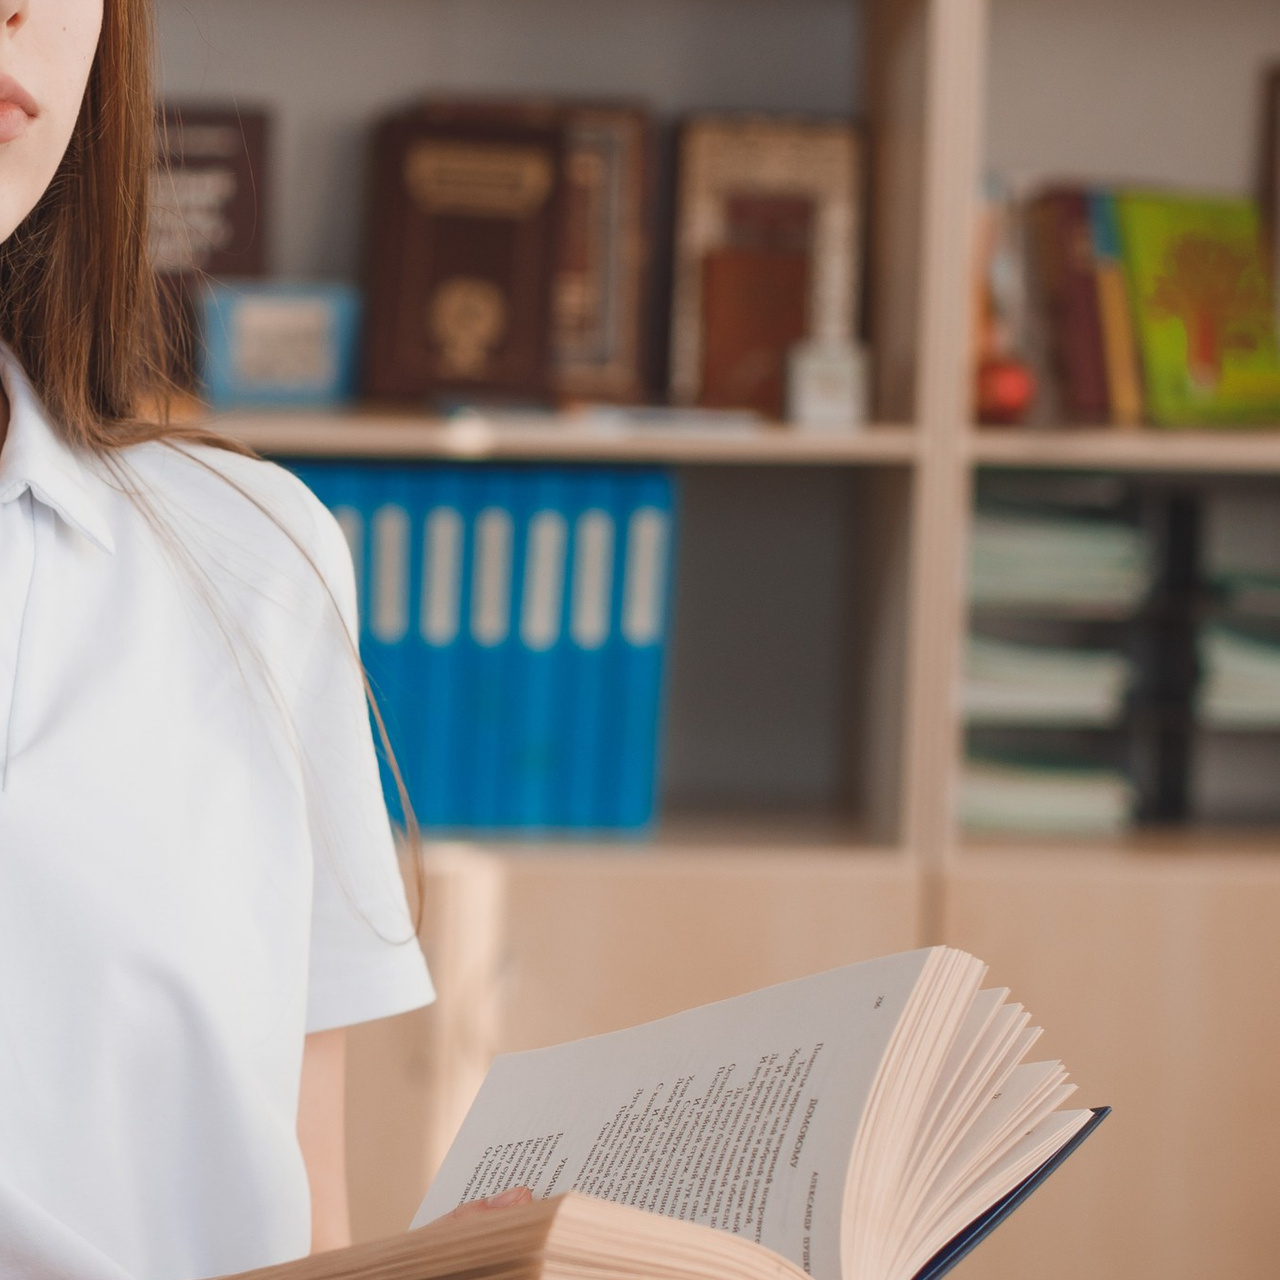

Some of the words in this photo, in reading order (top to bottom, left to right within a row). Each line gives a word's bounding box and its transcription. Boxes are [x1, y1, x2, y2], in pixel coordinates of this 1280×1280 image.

[763, 1067, 772, 1078] не
[768, 1053, 779, 1065] Да
[782, 1048, 801, 1077] Храни
[790, 1061, 806, 1083] Тебя
[667, 1078, 685, 1103] Люби
[679, 1075, 695, 1098] Ходи
[700, 1066, 726, 1109] Постигни
[709, 1063, 736, 1108] Останься,
[743, 1066, 762, 1091] ветра
[623, 1088, 644, 1112] Луга,
[733, 1087, 744, 1100] Да
[749, 1080, 766, 1110] вредят
[754, 1076, 777, 1123] скромную
[777, 1084, 794, 1115] молю,
[634, 1092, 658, 1133] калиткой
[657, 1105, 670, 1122] мой
[664, 1099, 682, 1129] вокруг
[687, 1108, 695, 1118] от
[709, 1090, 733, 1133] Покроют
[718, 1109, 733, 1131] пору
[782, 1090, 801, 1131] мирного
[596, 1122, 611, 1141] Они
[601, 1105, 627, 1148] Прохладу
[622, 1114, 640, 1139] Люби
[642, 1124, 660, 1154] малый
[643, 1118, 654, 1133] сей
[655, 1131, 666, 1147] его
[660, 1100, 691, 1155] Счастливый
[680, 1111, 703, 1156] робостью
[695, 1109, 714, 1143] тайный
[735, 1113, 752, 1143] полям
[742, 1125, 757, 1153] семьи
[758, 1120, 769, 1137] лес
[769, 1116, 781, 1136] мой
[790, 1099, 818, 1168] ДОМОВОМУ
[482, 1146, 493, 1160] От
[492, 1144, 503, 1157] От
[500, 1143, 514, 1161] Кто
[506, 1141, 524, 1164] Кому
[530, 1137, 544, 1155] Дни
[535, 1135, 554, 1162] Вдали
[540, 1132, 564, 1170] Блажен,
[592, 1150, 604, 1166] лип
[615, 1135, 637, 1171] ветхою,
[620, 1135, 646, 1181] укромный
[690, 1136, 712, 1180] влажный
[713, 1137, 731, 1176] осенние
[757, 1138, 773, 1176] добрый
[766, 1133, 785, 1183] незримый
[517, 1156, 533, 1181] делит
[576, 1143, 599, 1181] знакомы
[596, 1152, 611, 1175] моей
[634, 1155, 645, 1170] сад
[647, 1157, 663, 1186] домик
[680, 1145, 698, 1177] страж,
[696, 1133, 724, 1197] благотворны
[720, 1145, 738, 1187] опасный
[733, 1156, 746, 1181] моей
[745, 1147, 759, 1177] дикий
[483, 1162, 502, 1192] скрыт,
[491, 1166, 509, 1195] судьба
[532, 1170, 543, 1187] кто
[630, 1149, 658, 1205] заботливым
[684, 1182, 695, 1199] тук
[700, 1179, 717, 1217] набеги;
[713, 1190, 724, 1213] хлад
[737, 1179, 749, 1209] садик
[804, 1171, 818, 1231] АЛЕКСАНДР
[732, 1212, 741, 1233] мой
